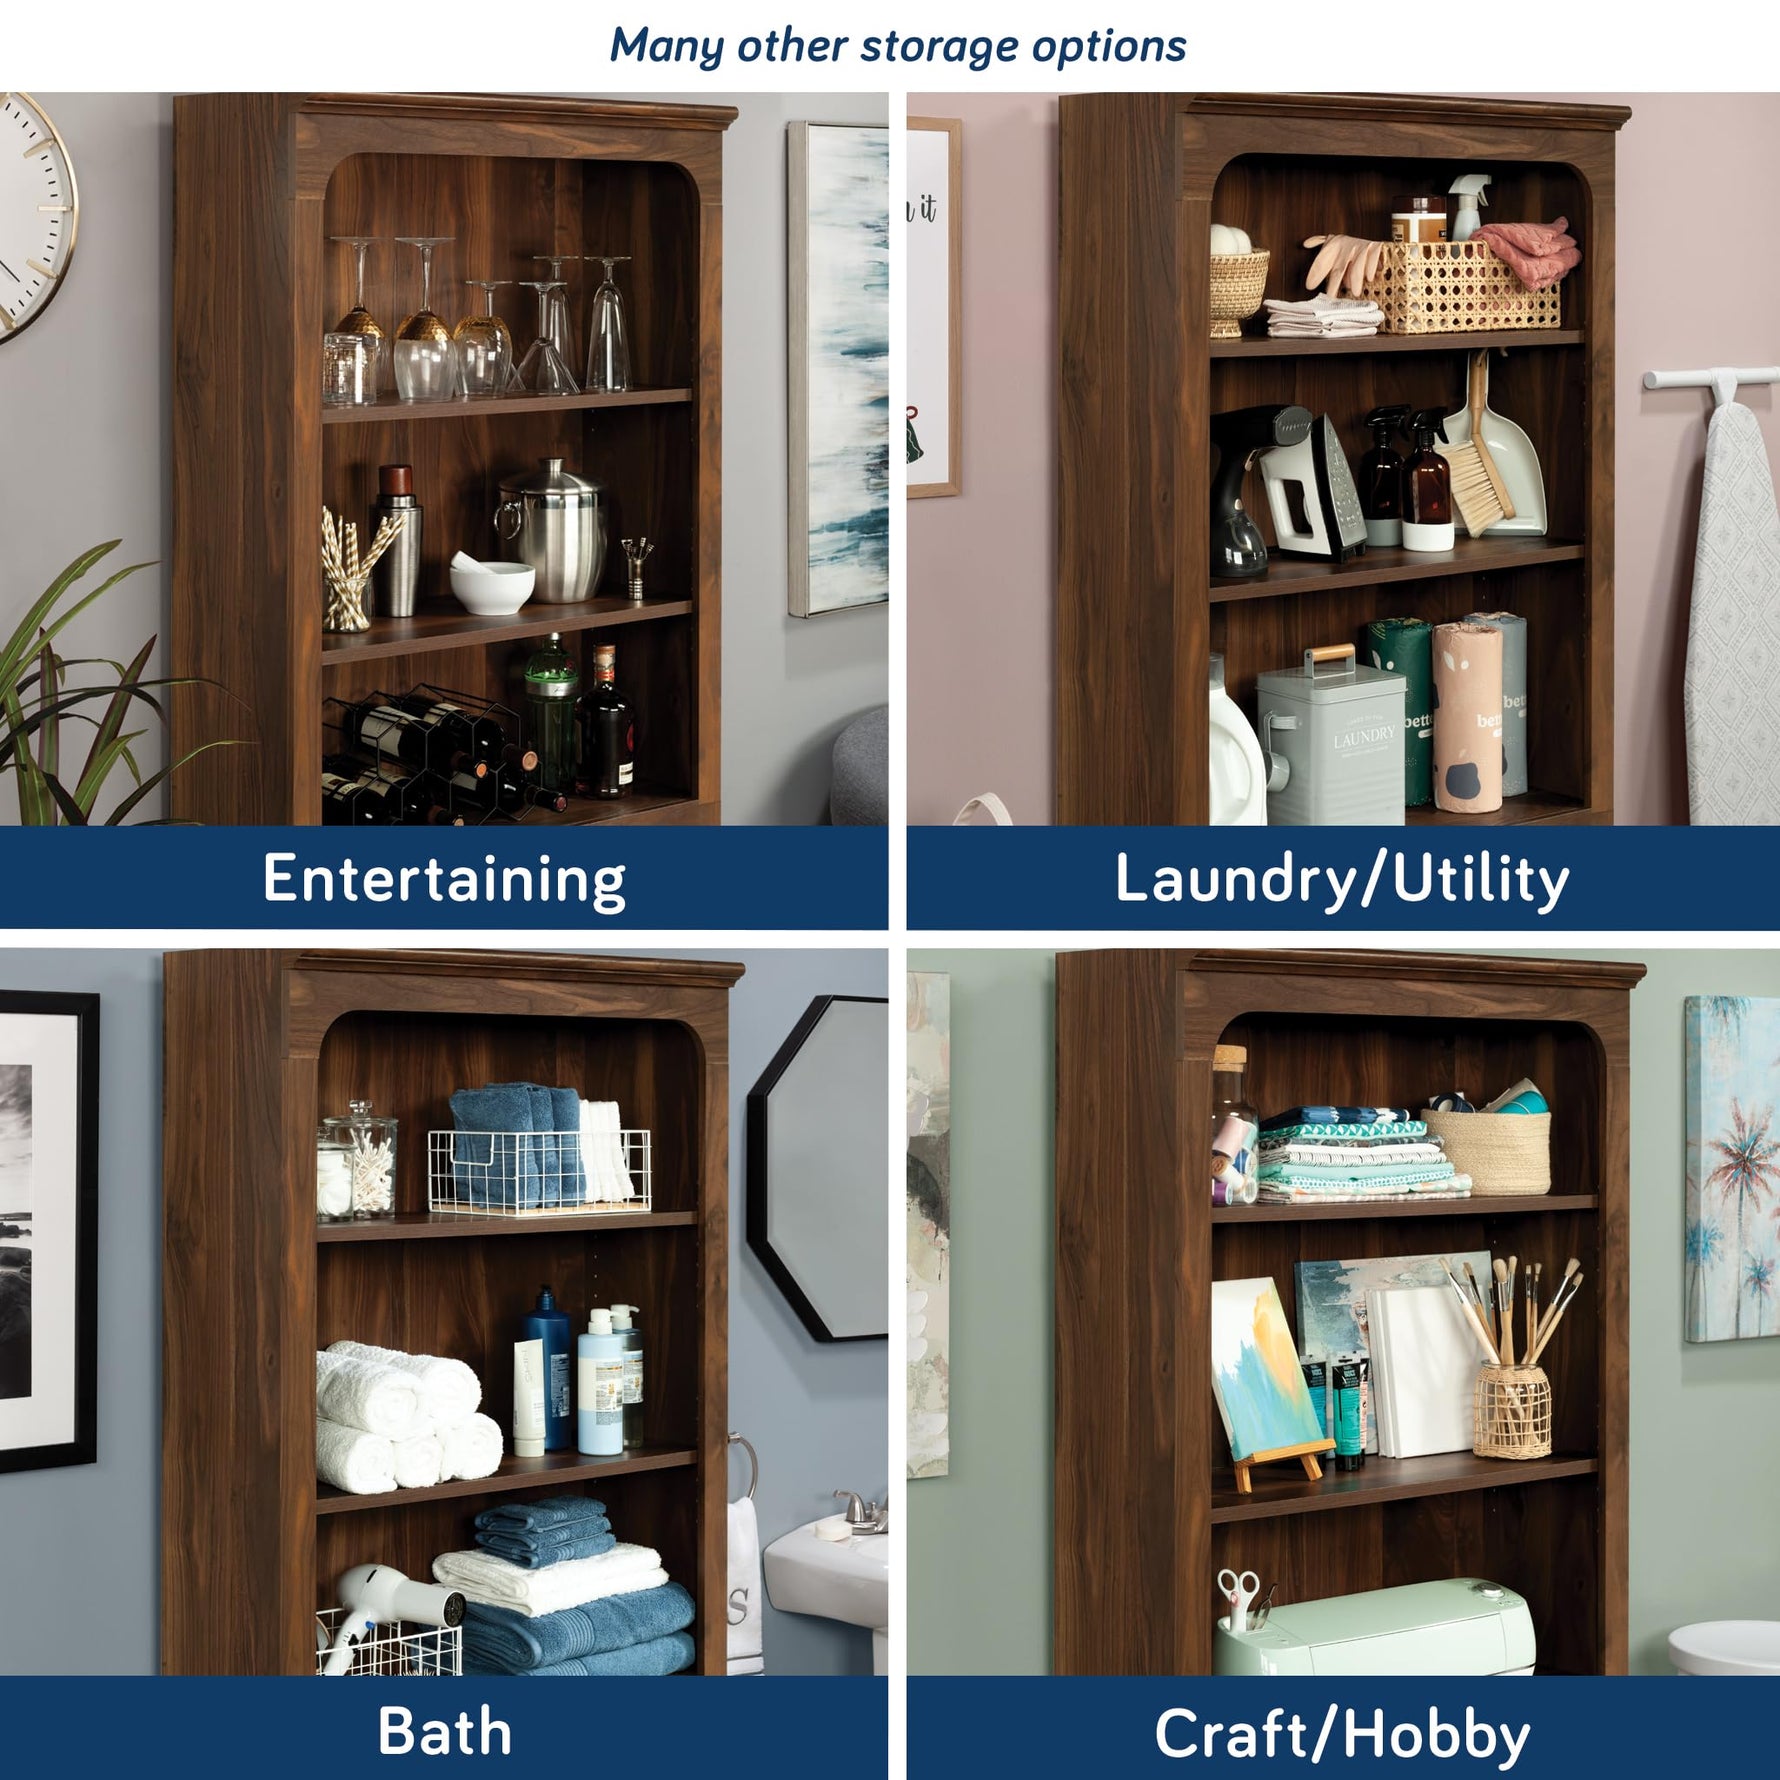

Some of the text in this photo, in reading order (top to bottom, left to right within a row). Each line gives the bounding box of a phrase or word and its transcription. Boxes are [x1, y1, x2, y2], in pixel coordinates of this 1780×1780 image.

[921, 194, 937, 223] it
[1334, 724, 1396, 750] LAUNDRY
[727, 1587, 749, 1626] S
